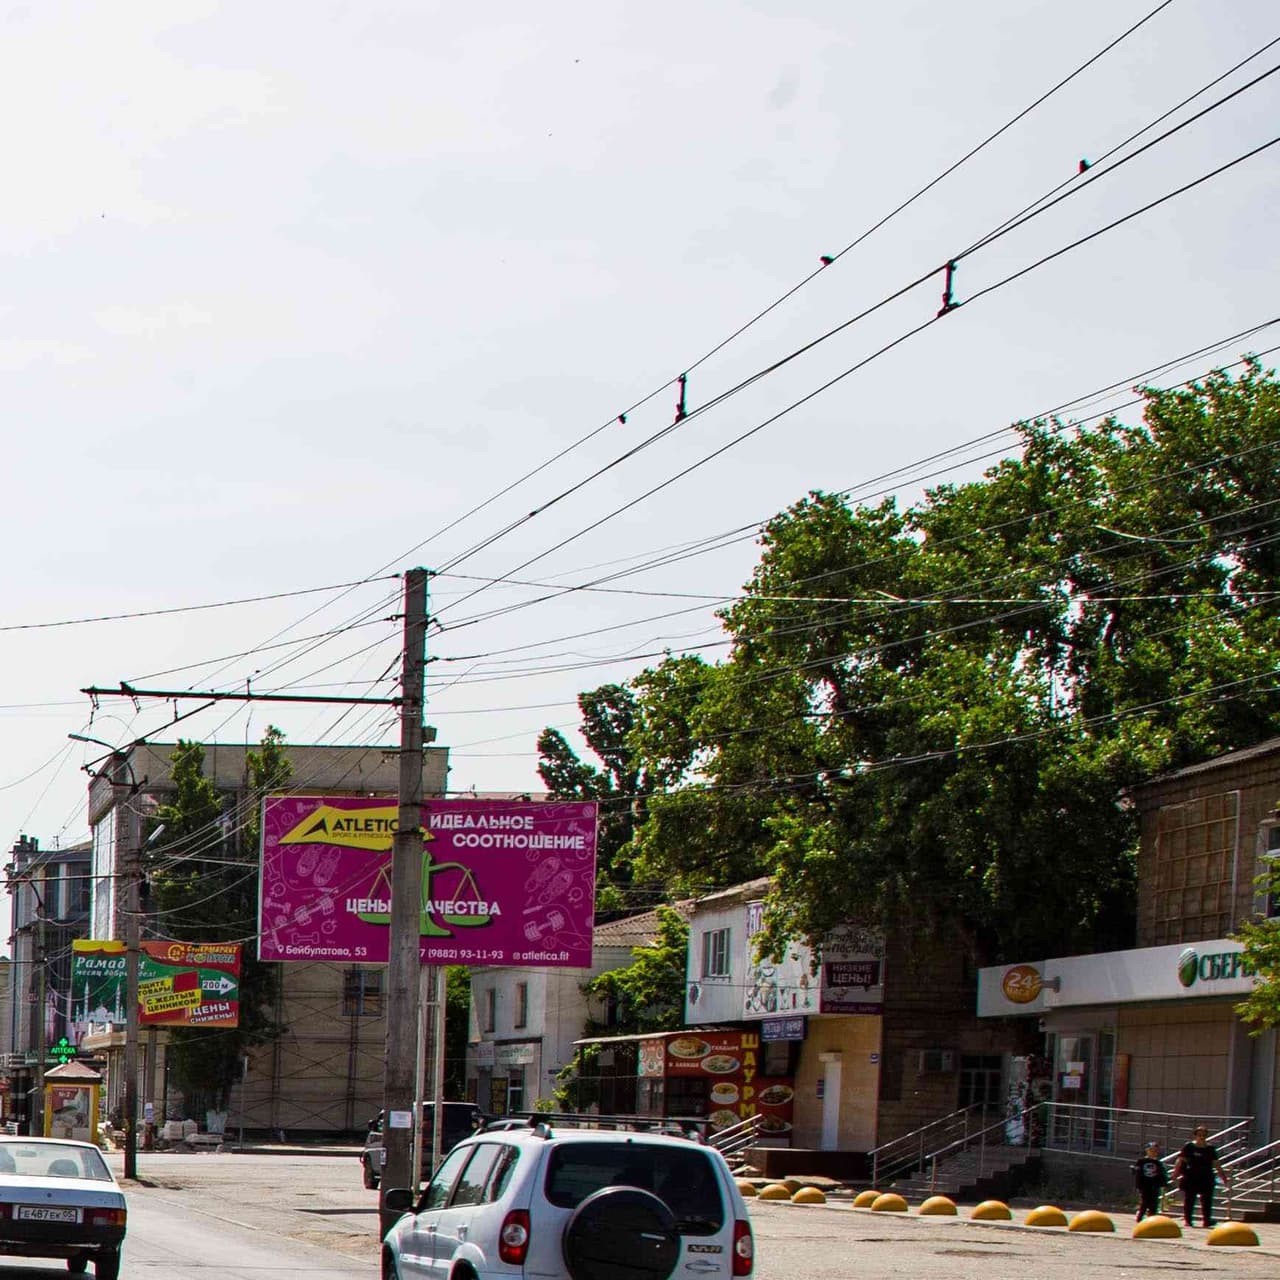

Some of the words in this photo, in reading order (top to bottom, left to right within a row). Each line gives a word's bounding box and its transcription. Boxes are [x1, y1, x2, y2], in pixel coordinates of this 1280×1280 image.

[332, 818, 399, 832] ATLETIC
[430, 814, 535, 830] ИДЕАЛЬНОЕ
[452, 833, 585, 849] СООТНОШЕНИЕ
[425, 900, 502, 916] АЧЕСТВА
[354, 947, 367, 956] 53
[460, 950, 504, 960] 93-11-93
[75, 956, 145, 970] Рамадн
[832, 973, 872, 984] ЦЕНЫ!
[1008, 972, 1033, 988] 24
[192, 1003, 230, 1016] ЦЕНЫ
